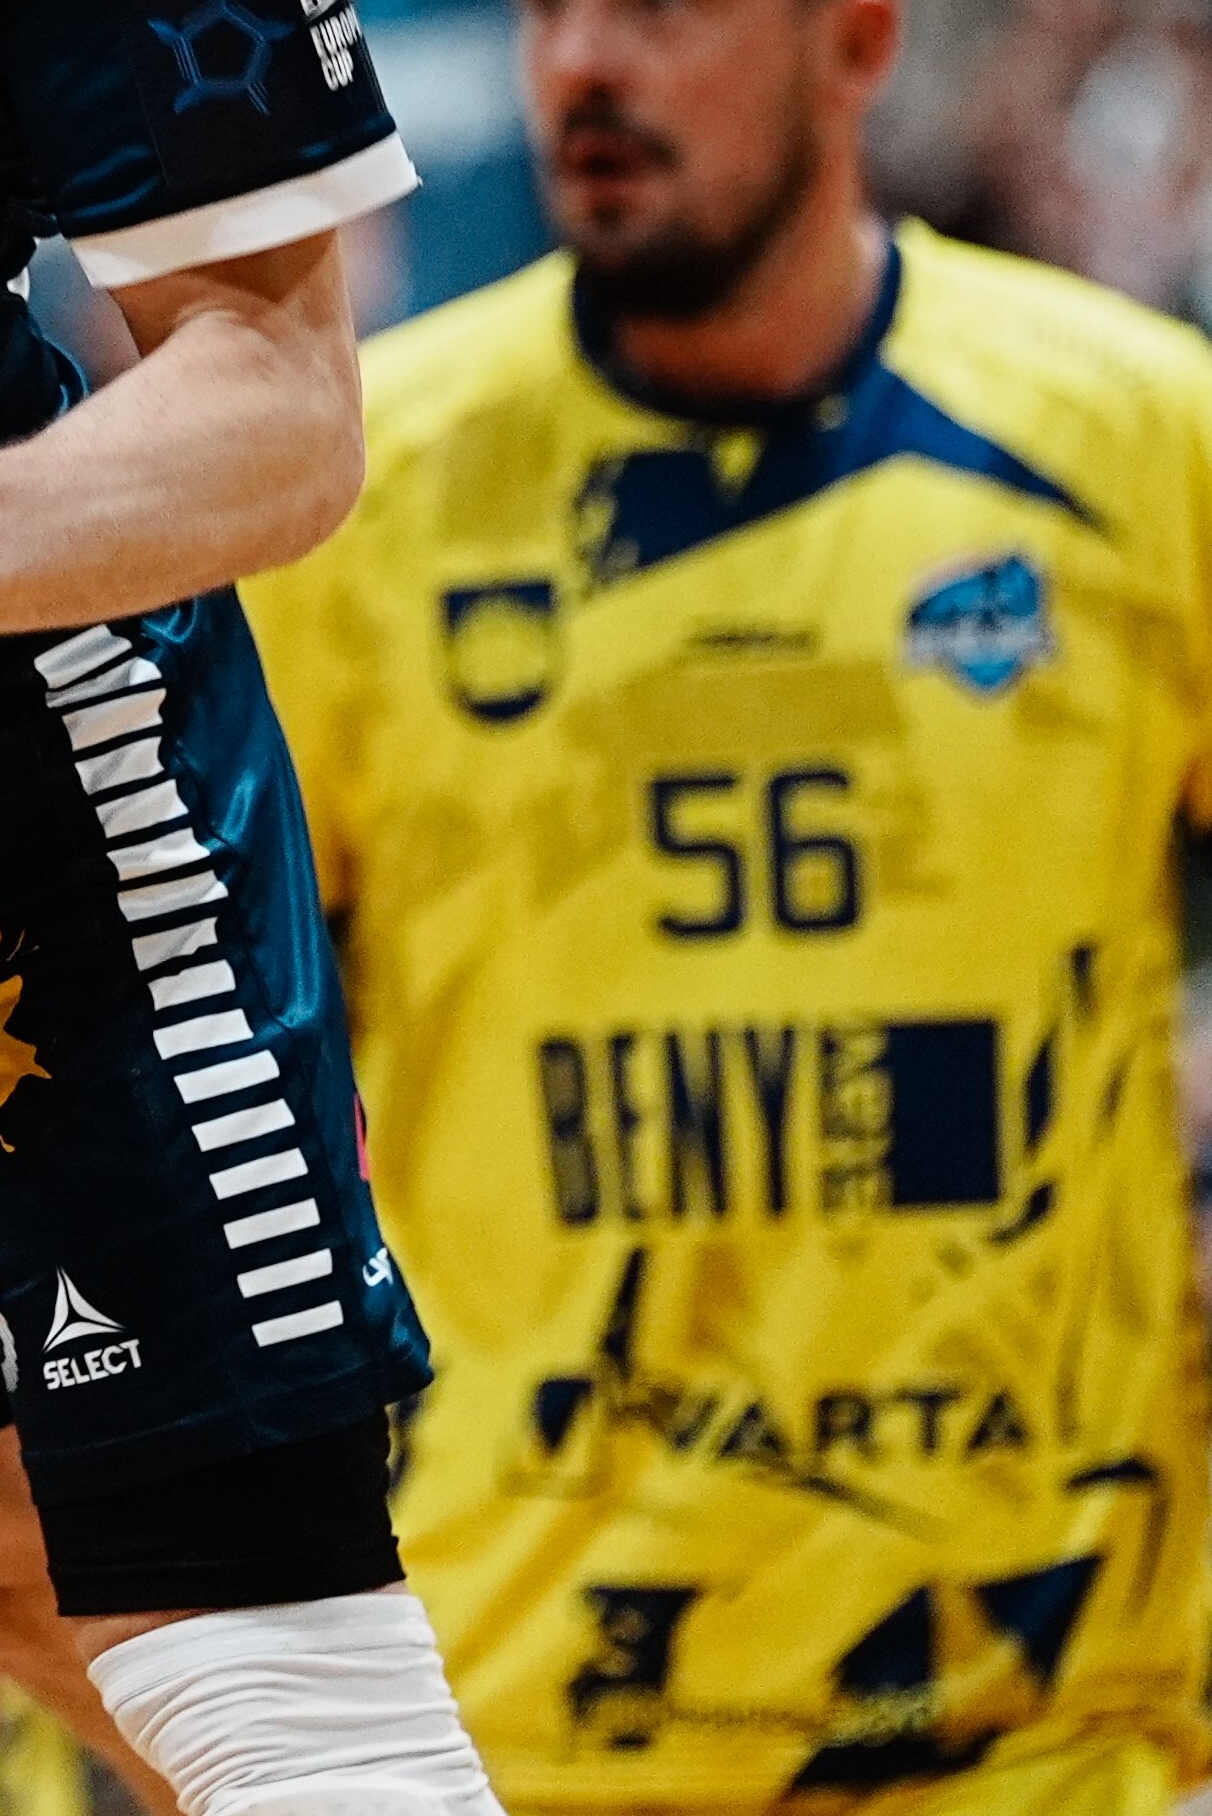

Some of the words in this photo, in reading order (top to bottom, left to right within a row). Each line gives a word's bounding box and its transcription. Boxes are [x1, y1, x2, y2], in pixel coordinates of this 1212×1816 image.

[646, 768, 860, 936] 56
[536, 1022, 796, 1226] BENY
[42, 1337, 142, 1391] SELECT
